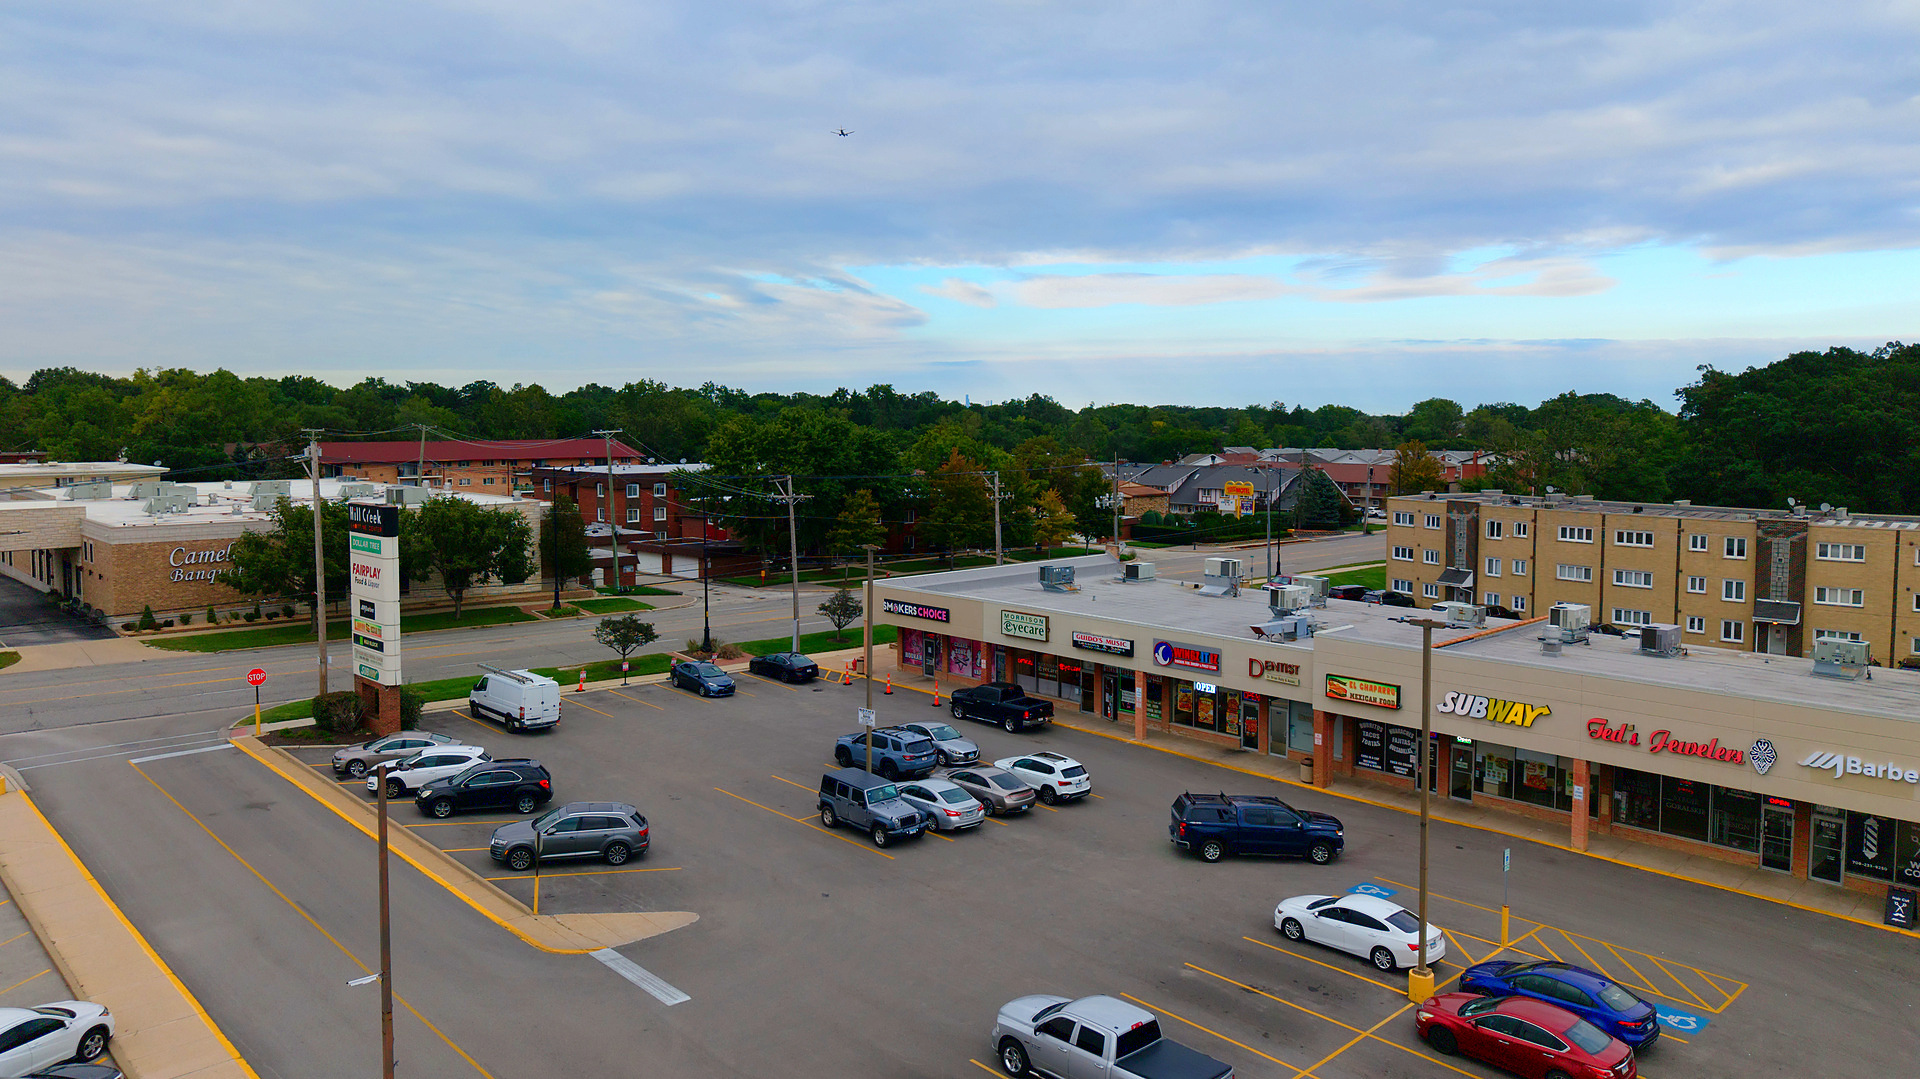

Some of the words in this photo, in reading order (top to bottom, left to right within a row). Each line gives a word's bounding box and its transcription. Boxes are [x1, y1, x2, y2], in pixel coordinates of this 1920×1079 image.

[350, 506, 360, 521] Hill
[362, 508, 381, 524] Creek
[353, 539, 368, 548] DOLLAR
[370, 542, 380, 550] TREE
[170, 542, 236, 567] Camel
[352, 563, 380, 580] FAIRPLAY
[355, 576, 363, 584] Food
[368, 580, 380, 589] Liquor
[883, 602, 917, 616] SMOKERS
[918, 607, 946, 620] CHOICE
[1004, 614, 1044, 624] MORRISON
[1076, 634, 1103, 643] GUIDO'S
[1106, 639, 1128, 647] MUSIC
[1174, 647, 1200, 662] WINGZ
[1201, 652, 1210, 663] IT
[1210, 654, 1219, 664] IZ
[1249, 658, 1300, 678] DENTIST
[248, 673, 265, 681] STOP
[1196, 682, 1216, 694] OPEN
[1350, 681, 1356, 690] EL
[1360, 683, 1396, 696] CHAPARRO
[1243, 691, 1260, 702] OPEN
[1350, 693, 1377, 704] MEXICAN
[1379, 698, 1395, 706] FOOD
[1436, 691, 1551, 728] SUBWAY
[1363, 731, 1380, 740] TACOS
[1457, 736, 1472, 744] Open
[1587, 718, 1640, 746] Ted's
[1650, 730, 1745, 765] Jewelers
[1846, 756, 1920, 785] Barbe
[1768, 797, 1790, 807] OPEN
